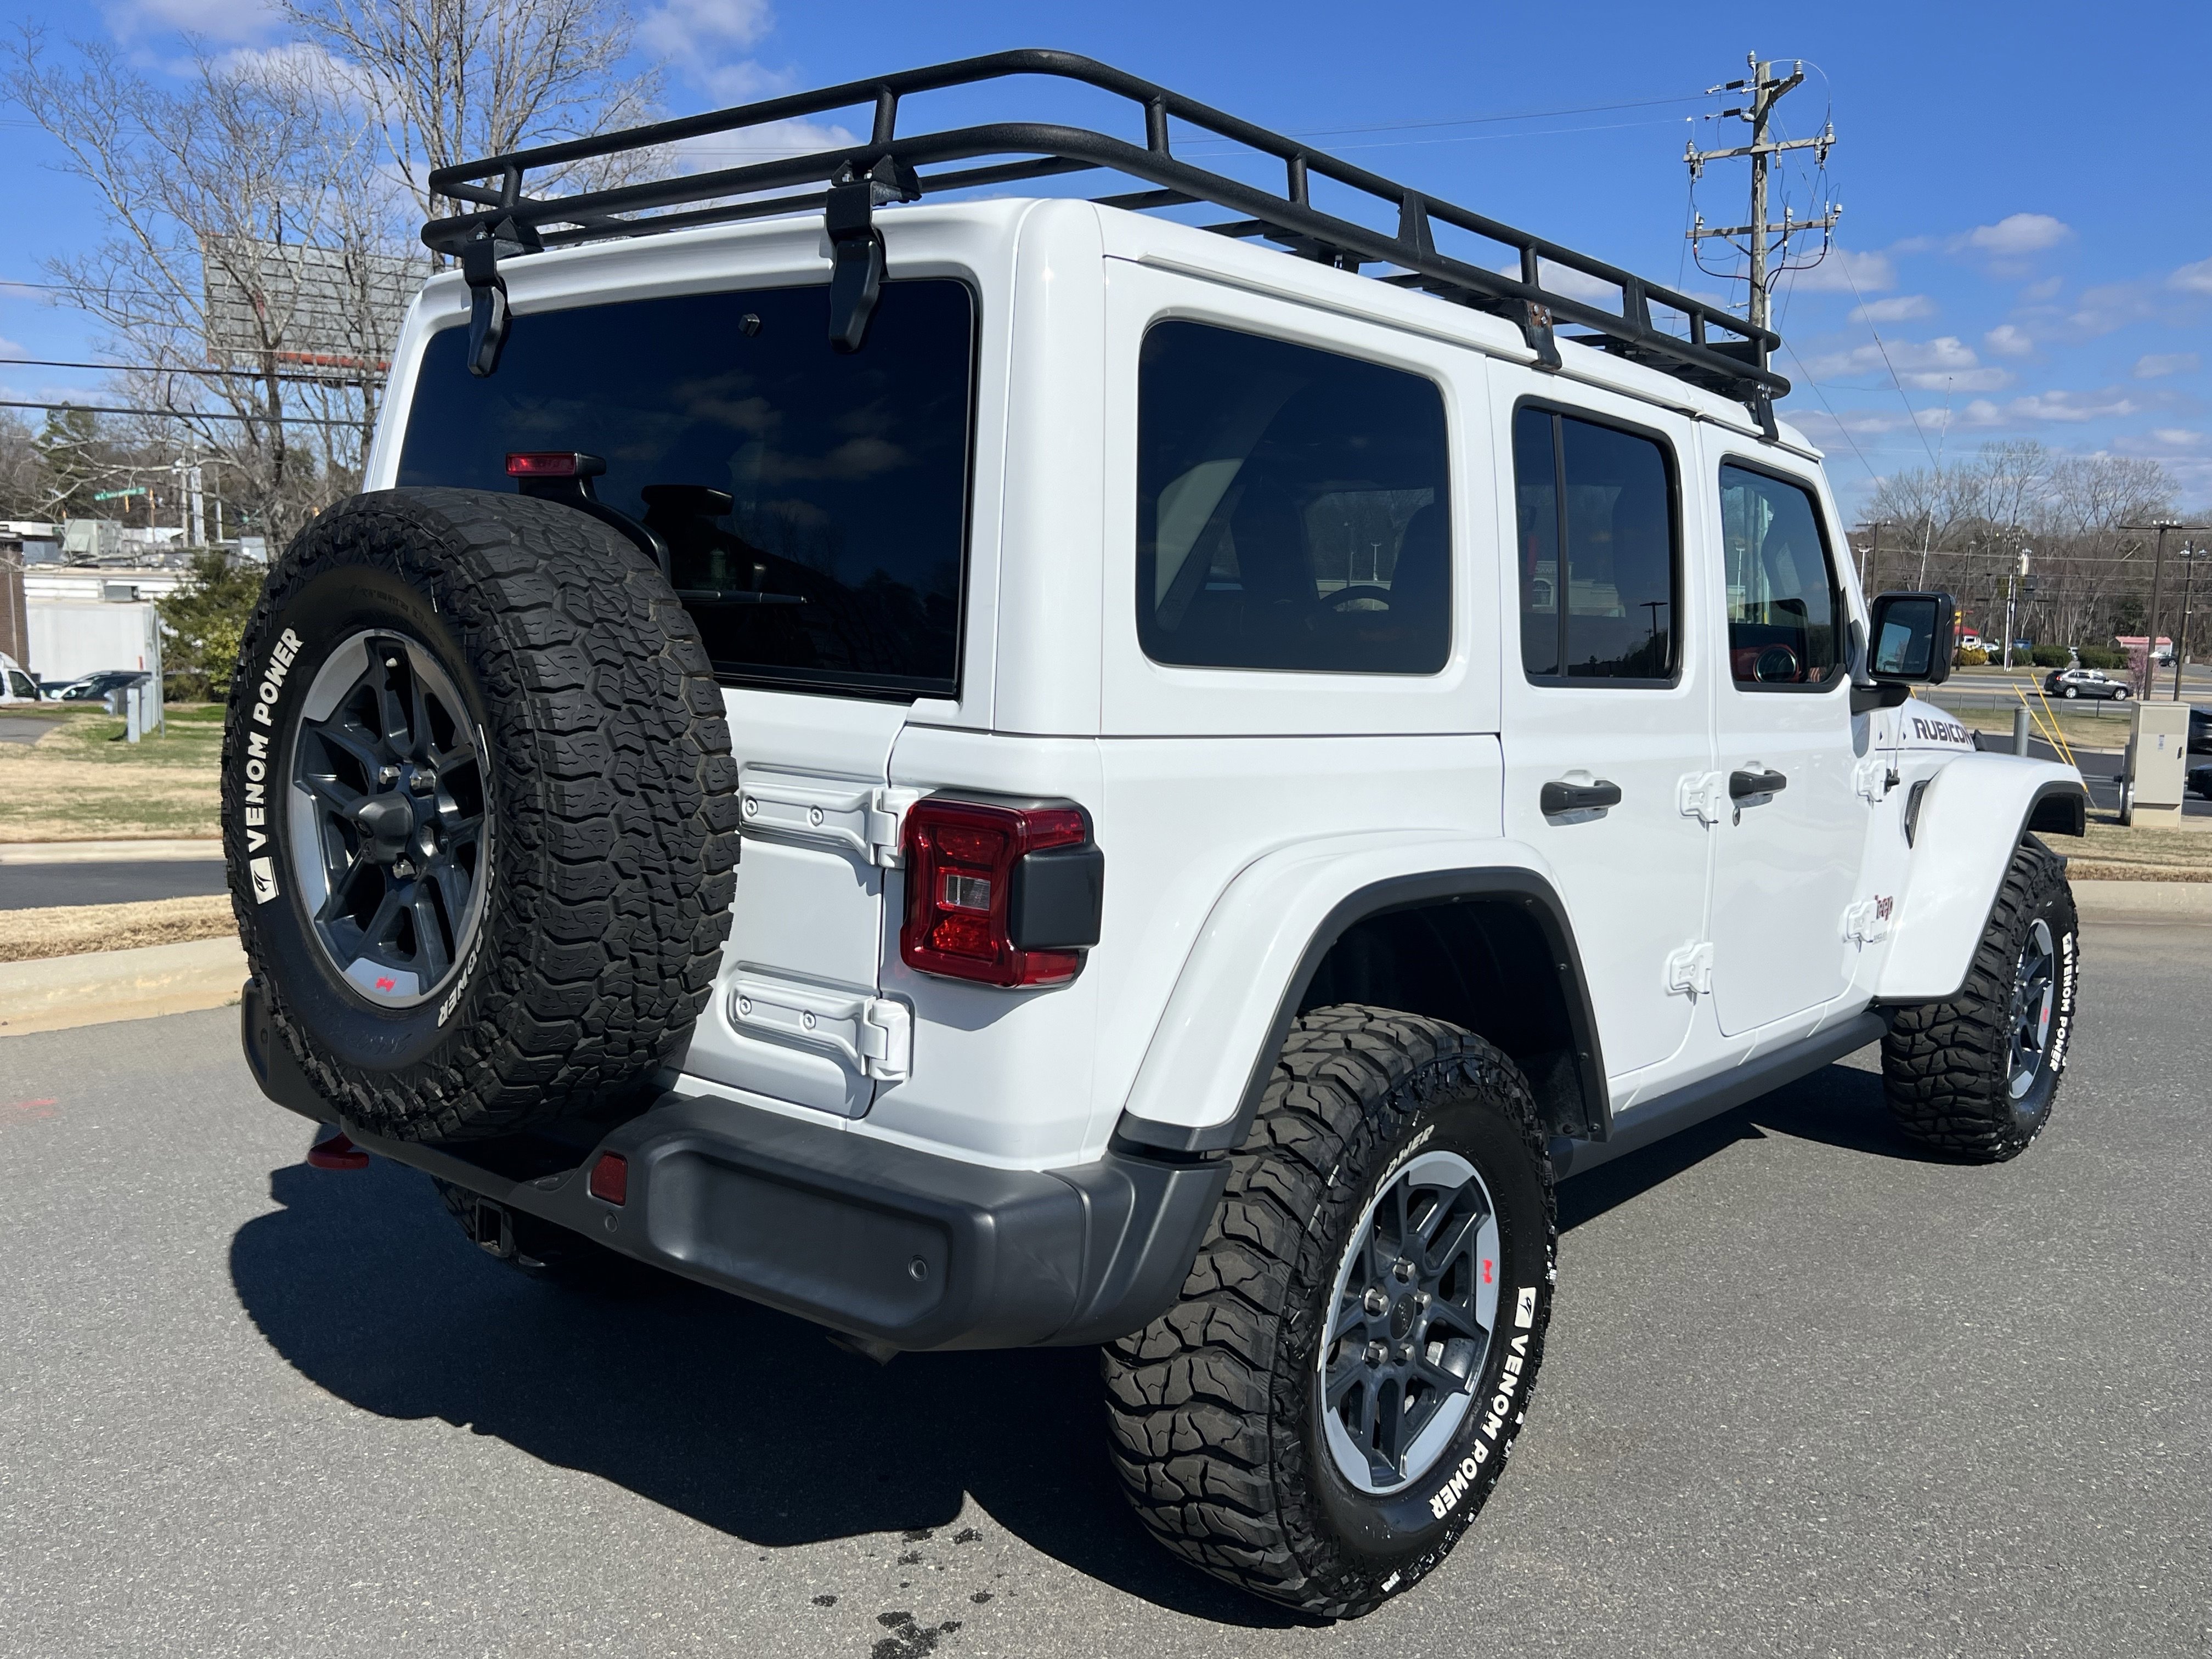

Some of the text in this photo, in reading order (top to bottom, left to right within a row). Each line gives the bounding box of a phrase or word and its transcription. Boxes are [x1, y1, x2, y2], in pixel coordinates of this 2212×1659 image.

[245, 628, 304, 853] VENOM POWER
[1911, 717, 1973, 746] RUBICON
[438, 926, 484, 1027] POWER
[2050, 952, 2073, 1072] VENOM POWER
[1374, 1124, 1435, 1195] POWER
[1429, 1334, 1529, 1520] VENOM POWER
